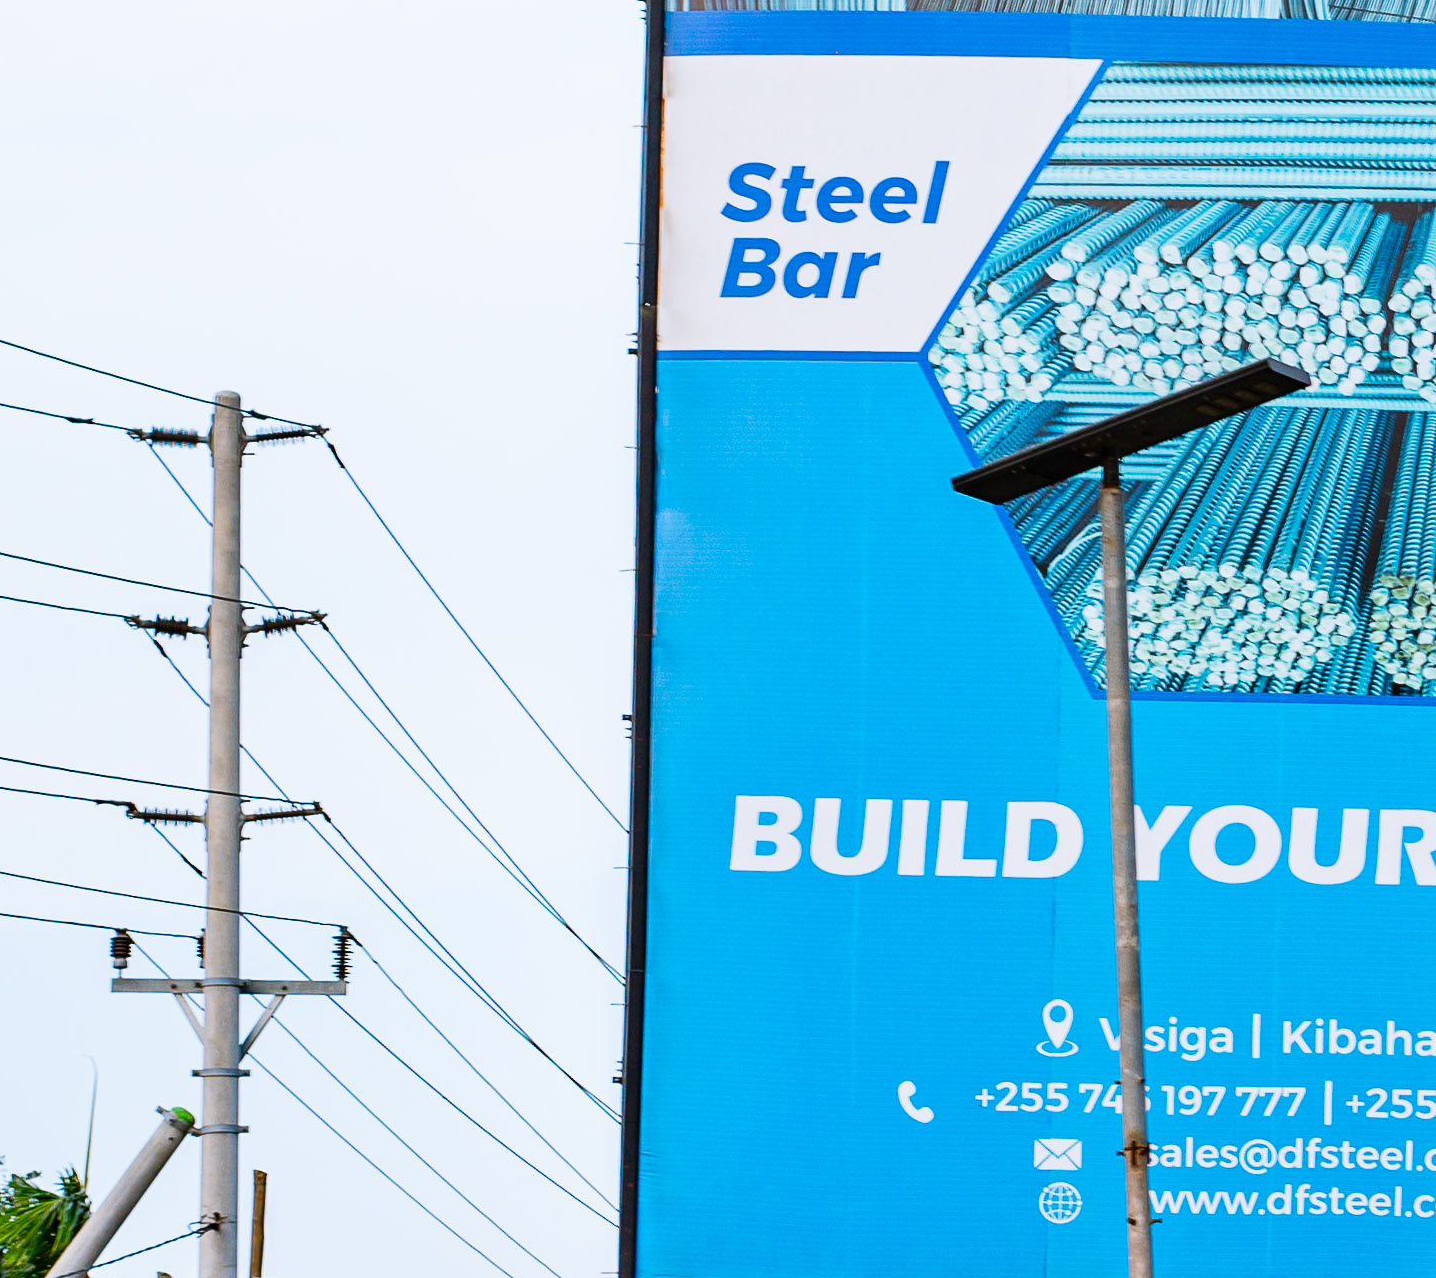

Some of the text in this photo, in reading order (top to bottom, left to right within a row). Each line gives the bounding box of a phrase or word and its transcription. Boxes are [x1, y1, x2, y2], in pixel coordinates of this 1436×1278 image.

[720, 160, 950, 225] Steel
[719, 237, 881, 299] Bar
[729, 794, 1085, 879] BUILD
[1098, 1016, 1234, 1062] Vsiga
[974, 1081, 1070, 1113] +255
[1078, 1083, 1152, 1115] 74
[1161, 1085, 1227, 1116] 197
[1234, 1085, 1307, 1117] 777
